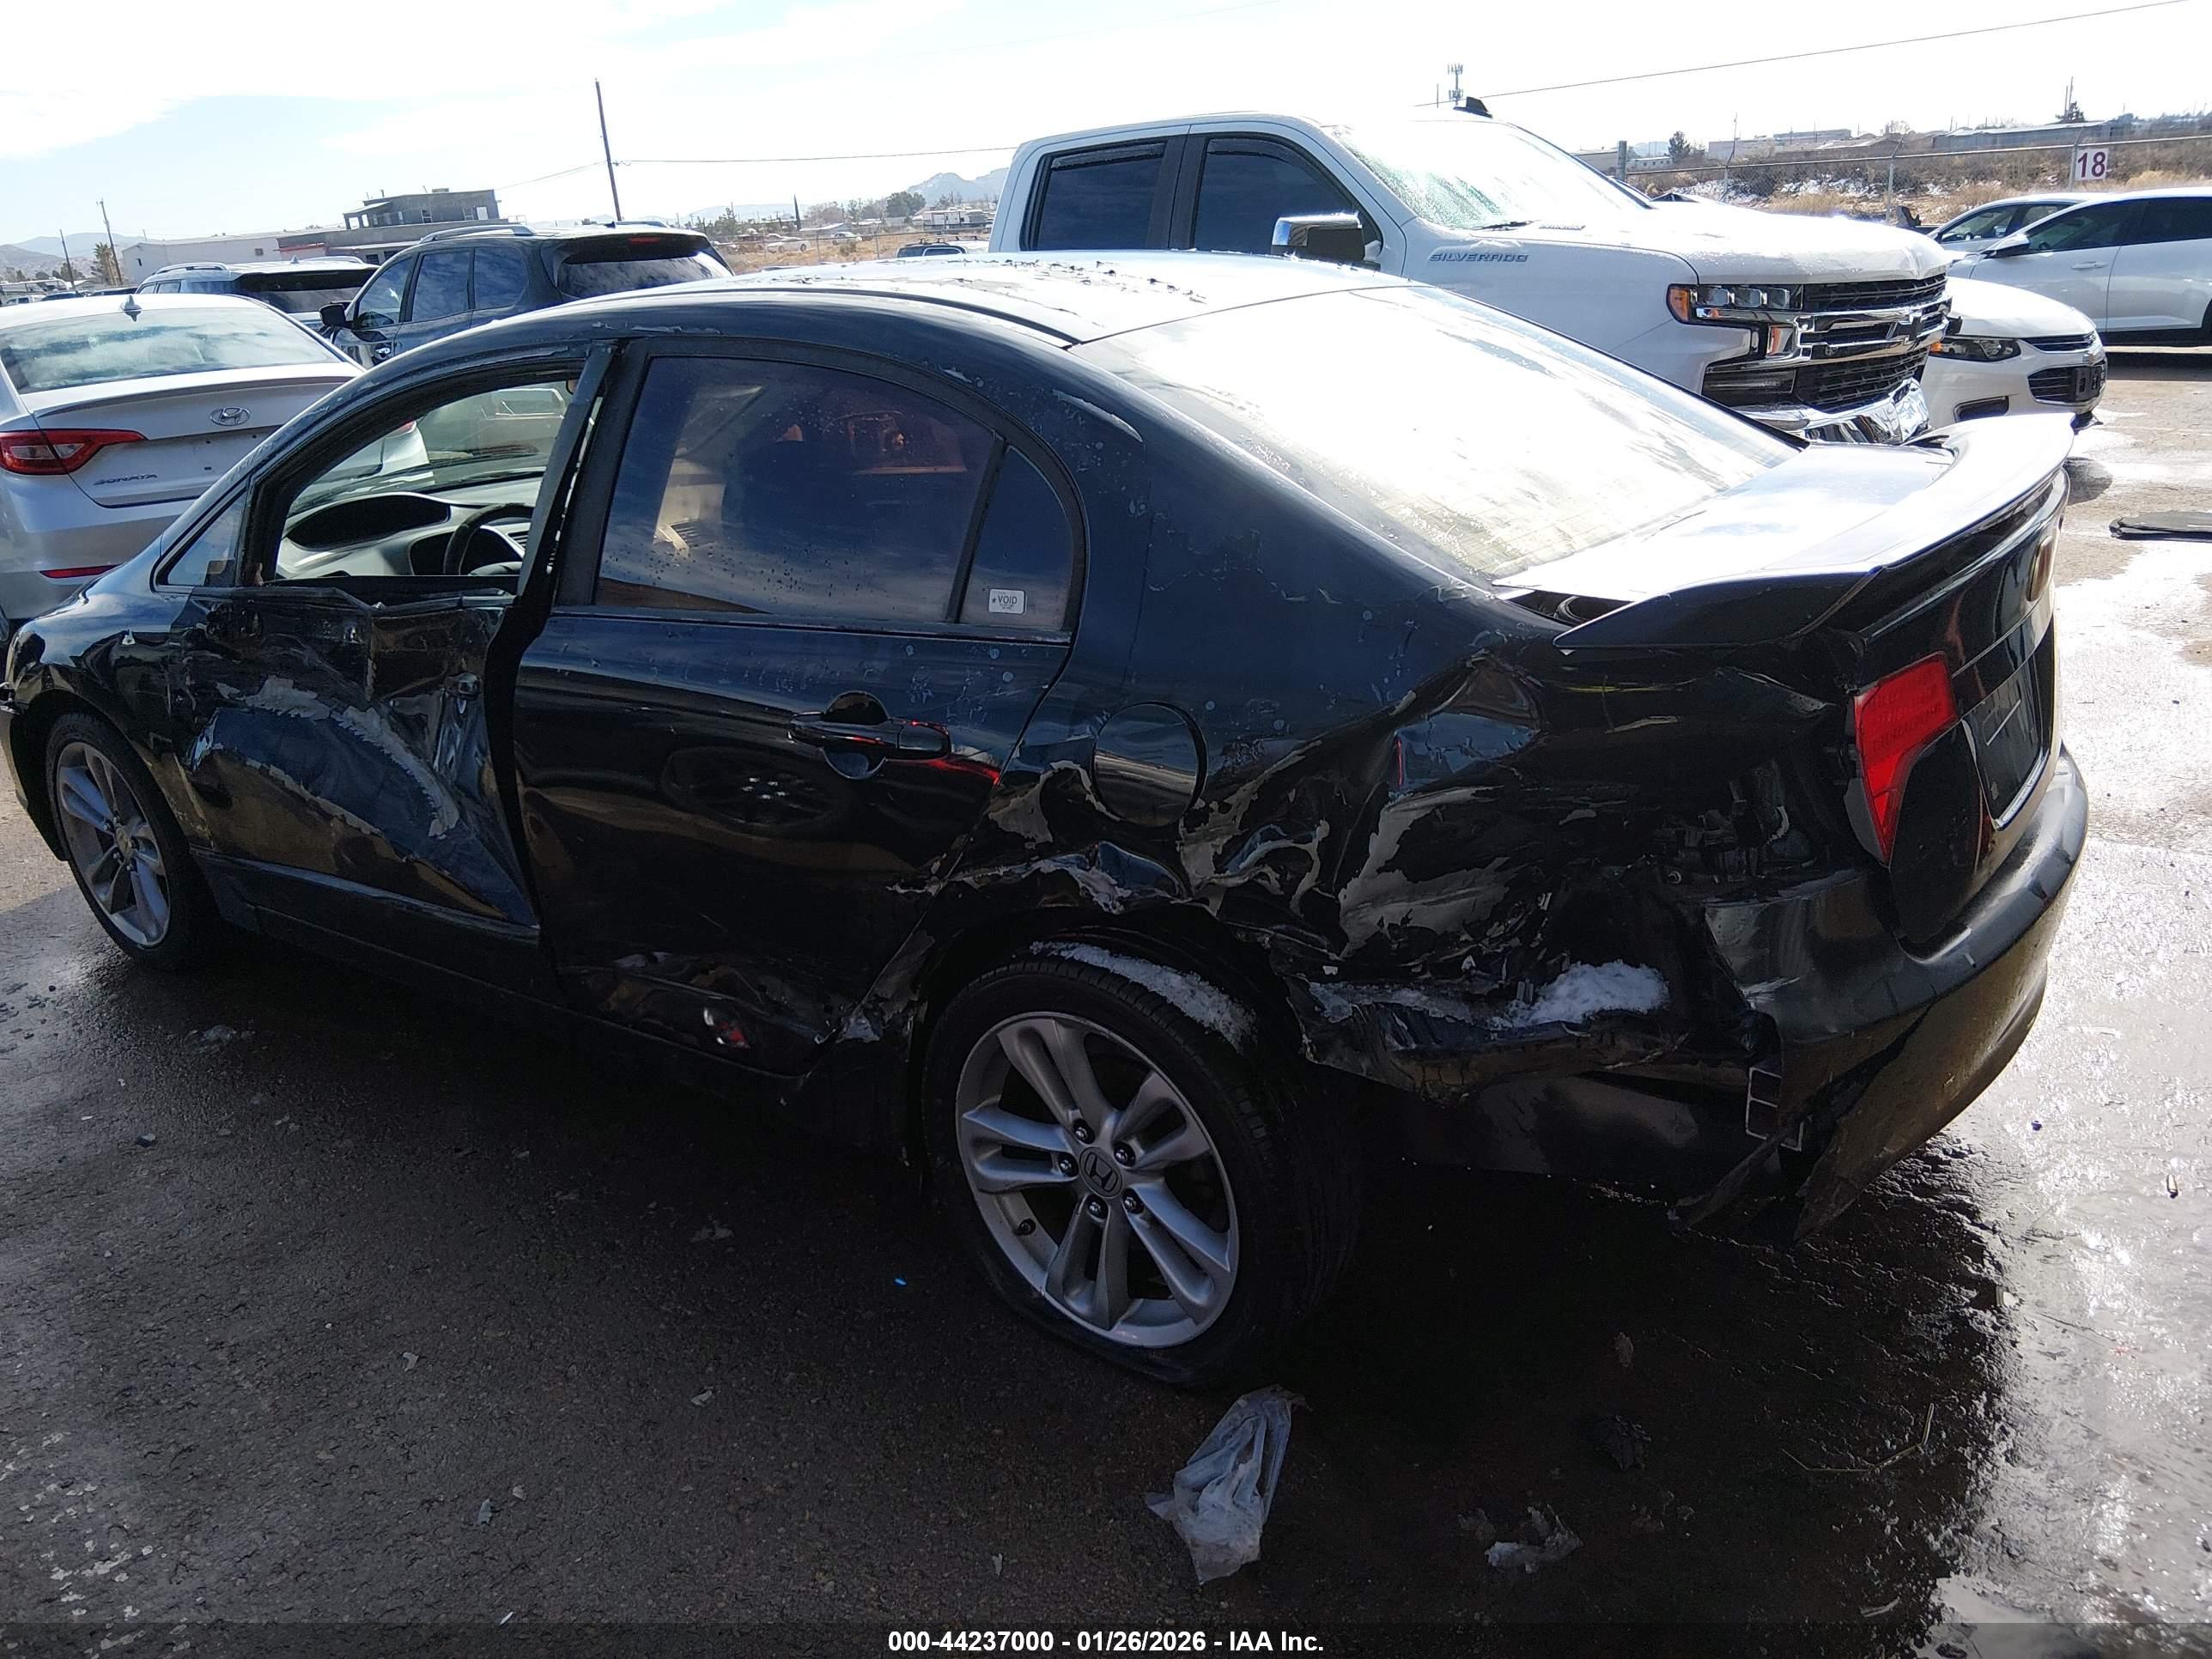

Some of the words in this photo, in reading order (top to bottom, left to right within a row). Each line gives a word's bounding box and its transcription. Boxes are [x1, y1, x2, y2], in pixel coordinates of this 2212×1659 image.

[2078, 151, 2106, 178] 18
[1429, 252, 1528, 263] SILVERADO
[93, 474, 158, 485] SONATA
[997, 595, 1018, 605] VOID
